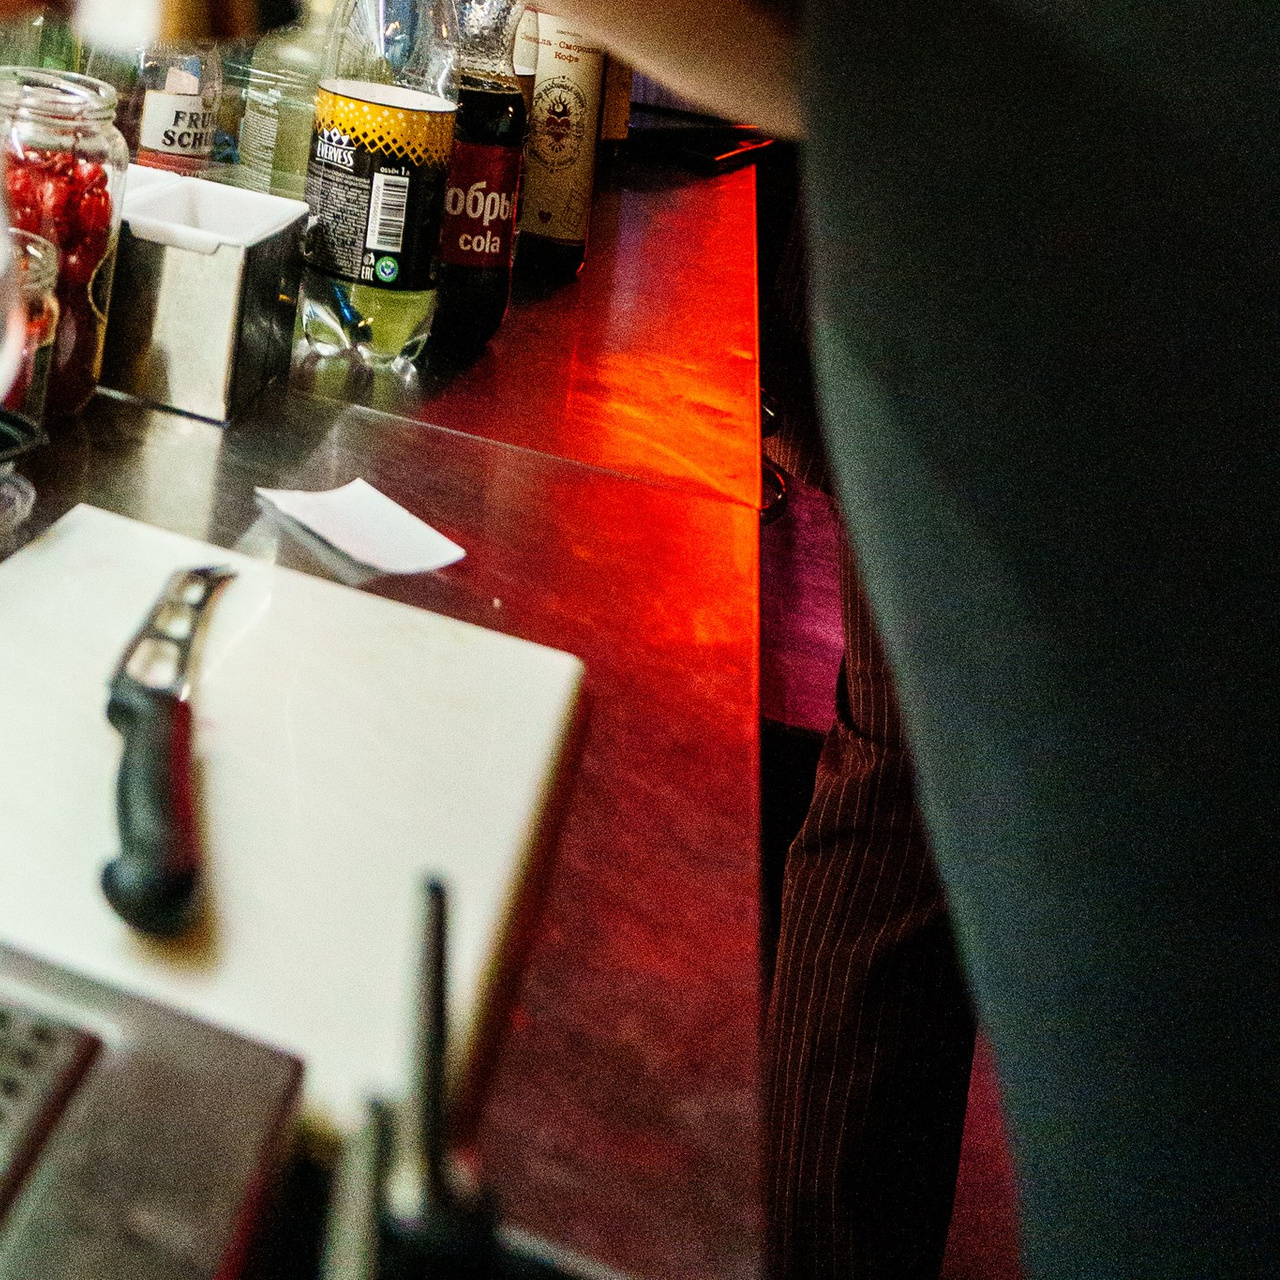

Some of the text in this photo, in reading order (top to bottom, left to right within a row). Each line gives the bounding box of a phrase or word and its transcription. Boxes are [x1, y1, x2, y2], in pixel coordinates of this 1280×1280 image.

[173, 110, 214, 129] FRU
[444, 180, 515, 227] обры
[458, 230, 501, 254] cola
